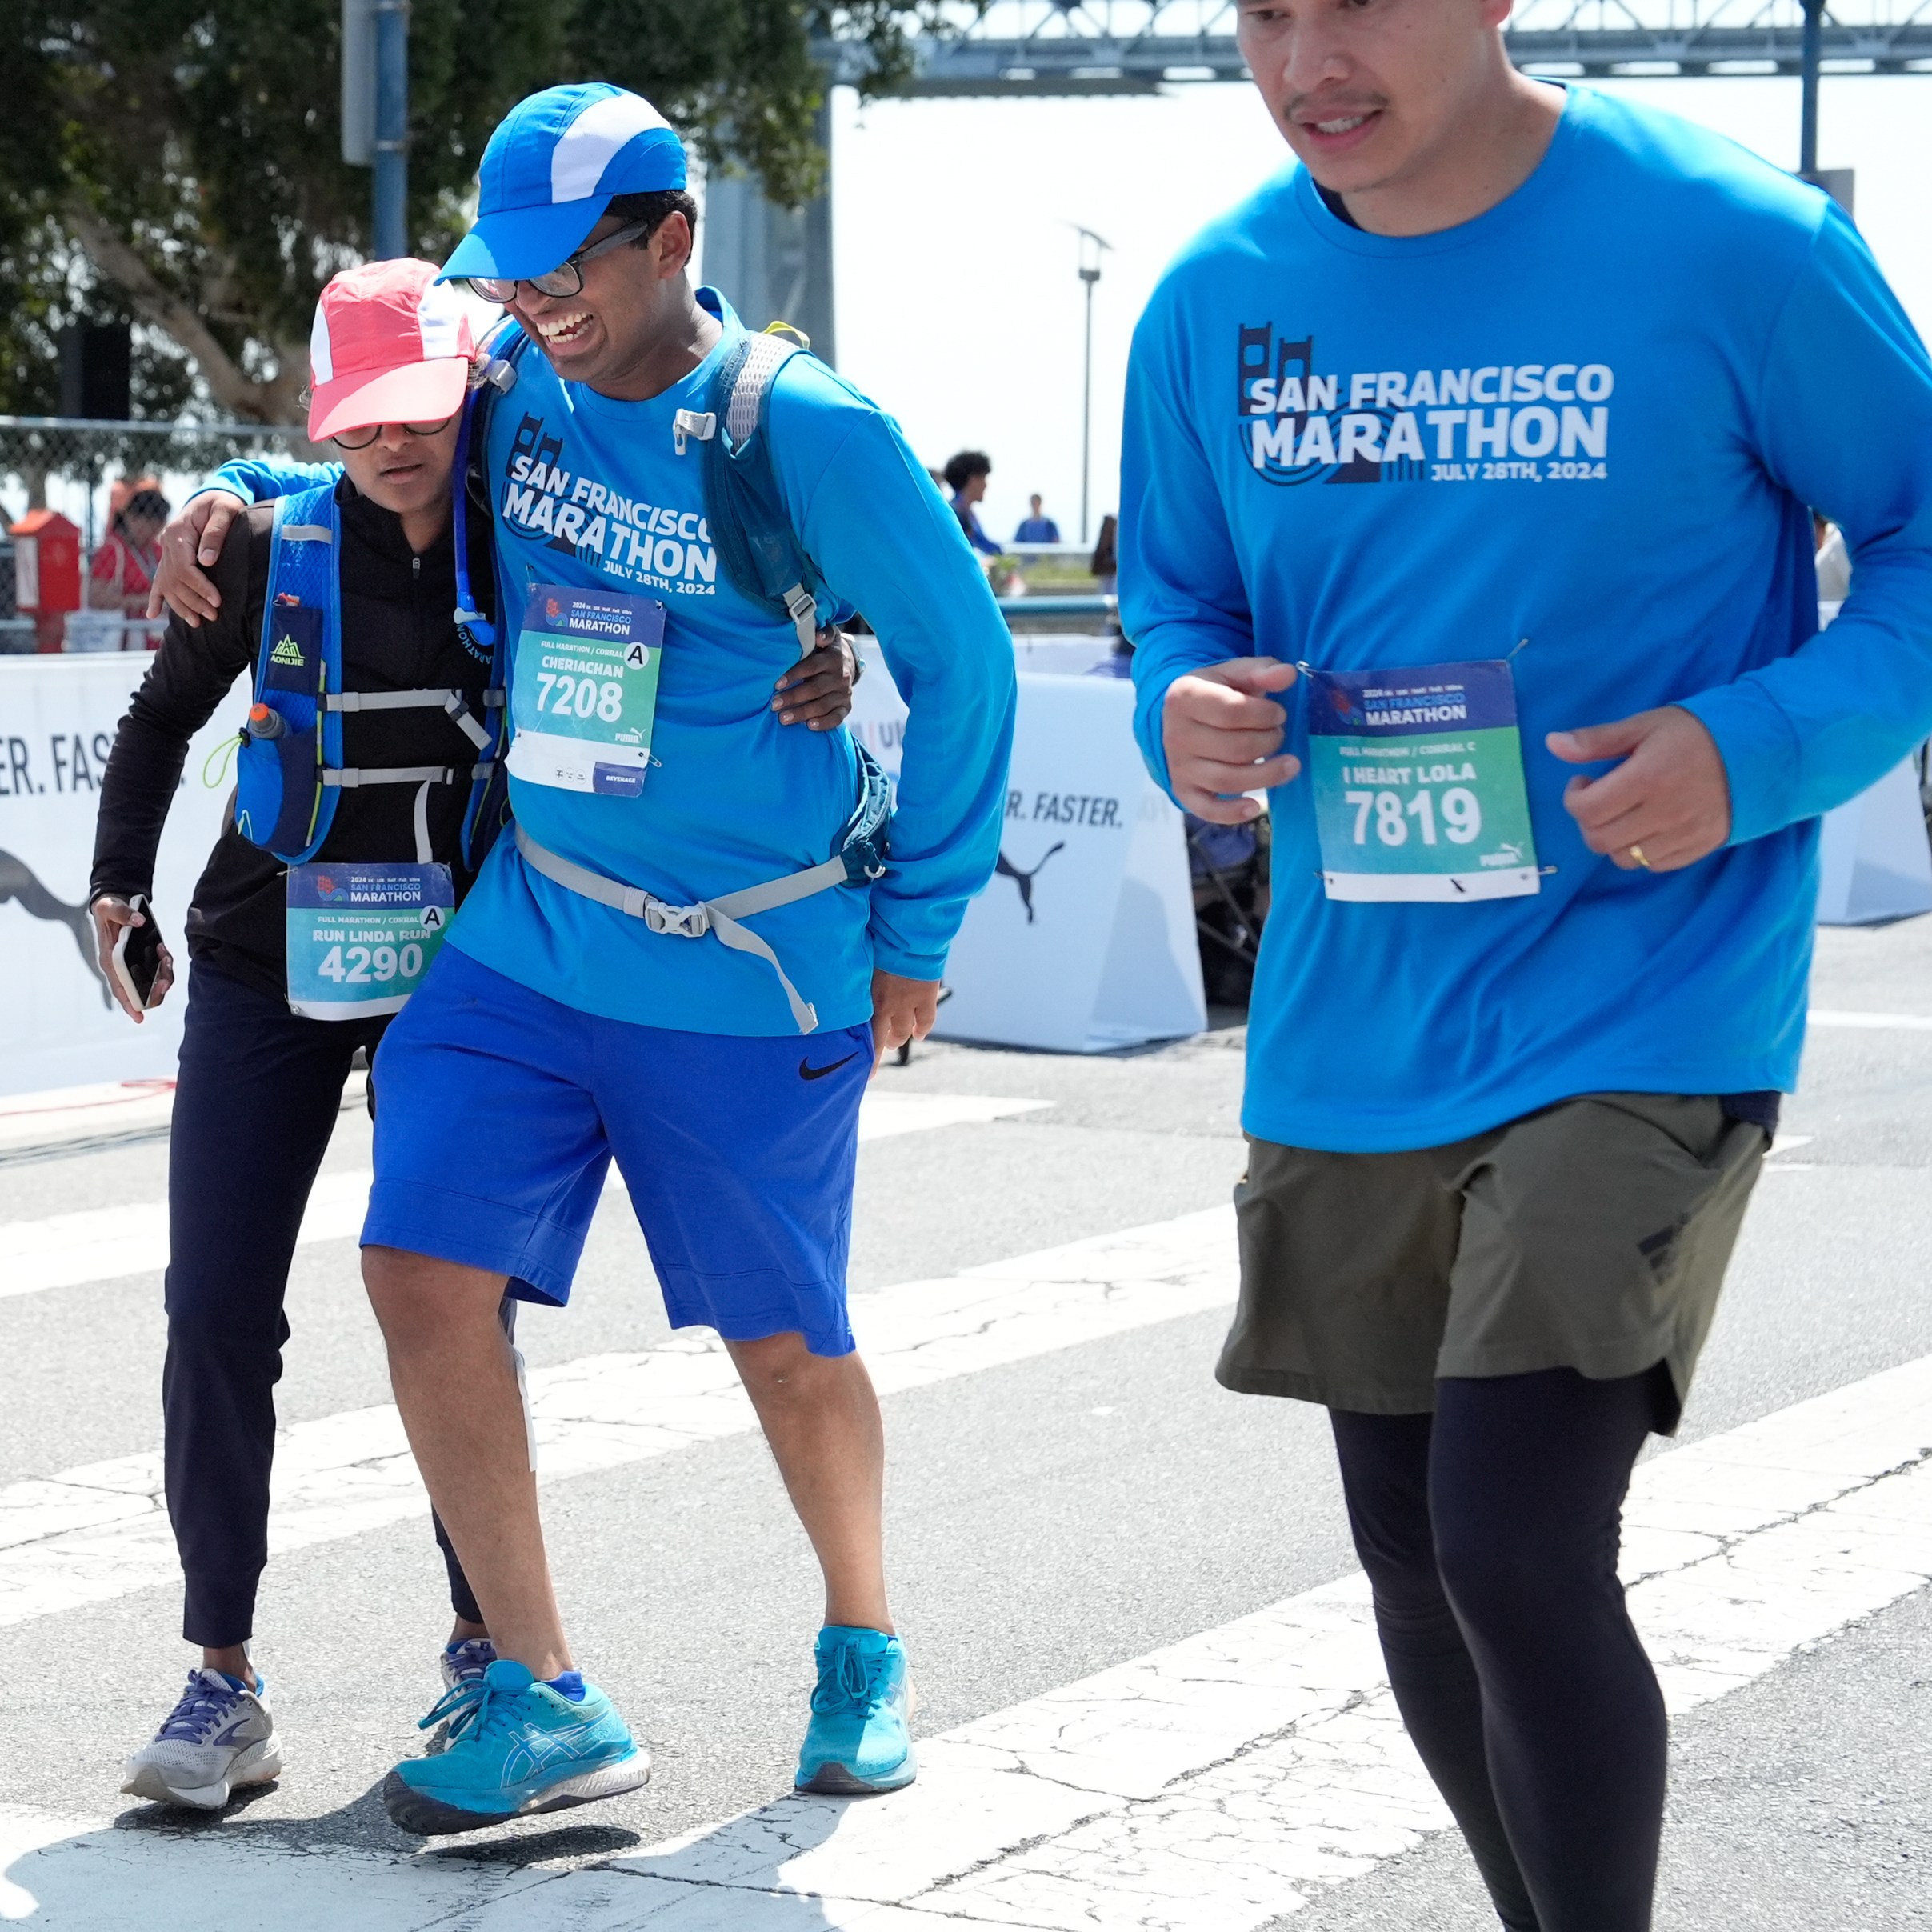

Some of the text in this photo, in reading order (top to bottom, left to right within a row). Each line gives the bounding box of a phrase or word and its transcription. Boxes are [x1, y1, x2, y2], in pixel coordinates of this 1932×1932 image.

[1250, 363, 1614, 414] SAN FRANCISCO
[1250, 406, 1609, 470] MARATHON
[511, 455, 570, 496] SAN
[1431, 462, 1608, 483] JULY 28TH, 2024
[502, 482, 717, 582] MARATHON
[603, 560, 716, 595] JULY 28TH, 2024
[569, 617, 630, 636] MARATHON
[570, 609, 632, 624] SAN FRANCISCO
[455, 624, 493, 665] ARATHON
[541, 641, 554, 650] FULL
[555, 642, 590, 654] MARATHON
[595, 648, 624, 658] CORRAL
[627, 645, 644, 665] A
[270, 655, 304, 666] AONIJIE
[542, 655, 624, 678] CHERIACHAN
[536, 672, 622, 722] 7208
[1365, 704, 1467, 726] MARATHON
[606, 775, 636, 783] BEVERAGE
[1342, 762, 1477, 785] I HEART LOLA
[1033, 791, 1122, 829] FASTER.
[1344, 787, 1482, 846] 7819
[350, 883, 421, 891] SAN FRANCISCO
[350, 891, 421, 902] MARATHON
[338, 916, 381, 924] MARATHON
[388, 916, 419, 924] CORRAL
[423, 908, 441, 926] A
[313, 929, 430, 942] RUN LINDA RUN
[318, 943, 422, 983] 4290
